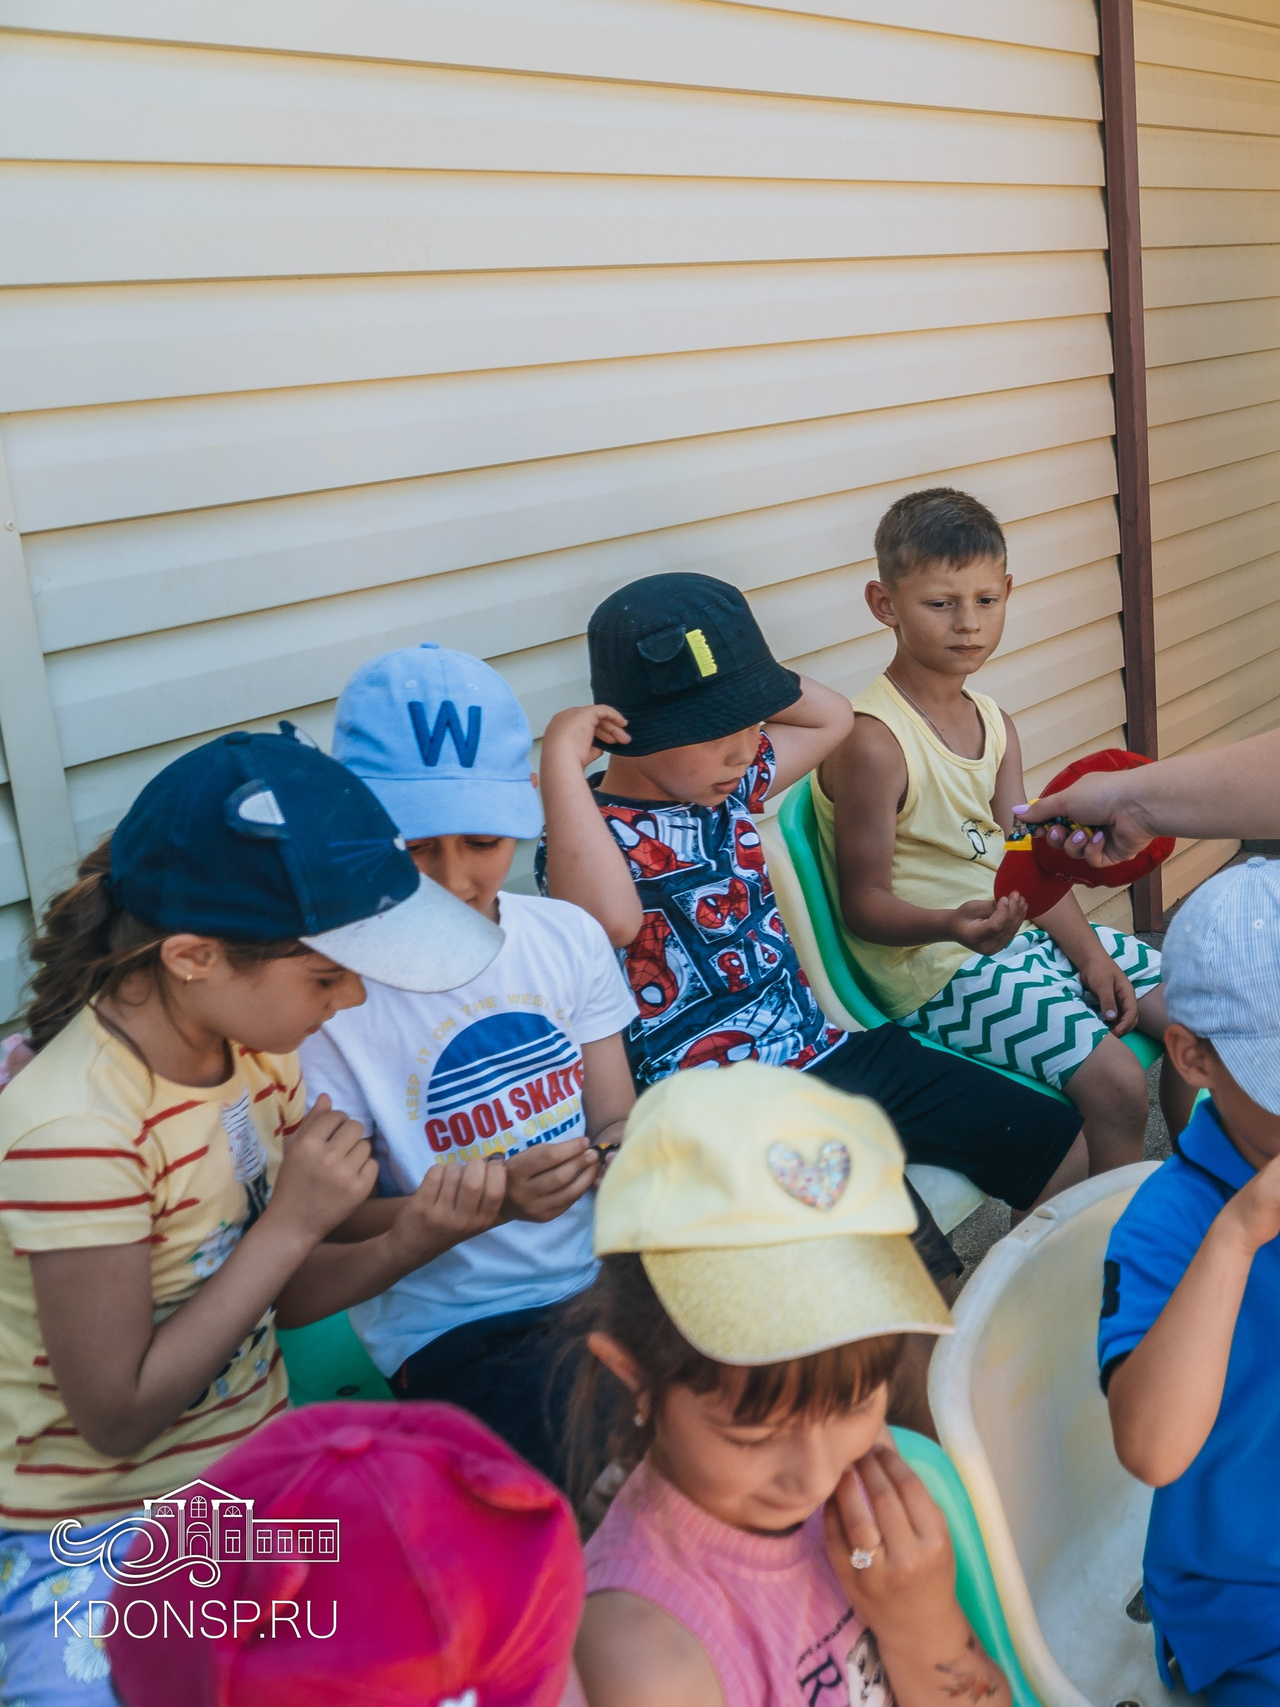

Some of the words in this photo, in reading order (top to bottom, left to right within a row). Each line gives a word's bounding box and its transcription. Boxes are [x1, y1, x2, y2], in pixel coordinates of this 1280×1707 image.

[407, 700, 482, 768] W
[406, 1073, 420, 1121] KEEP
[416, 1046, 432, 1065] IT
[433, 1016, 456, 1040] ON
[461, 995, 497, 1017] THE
[424, 1098, 513, 1154] COOL
